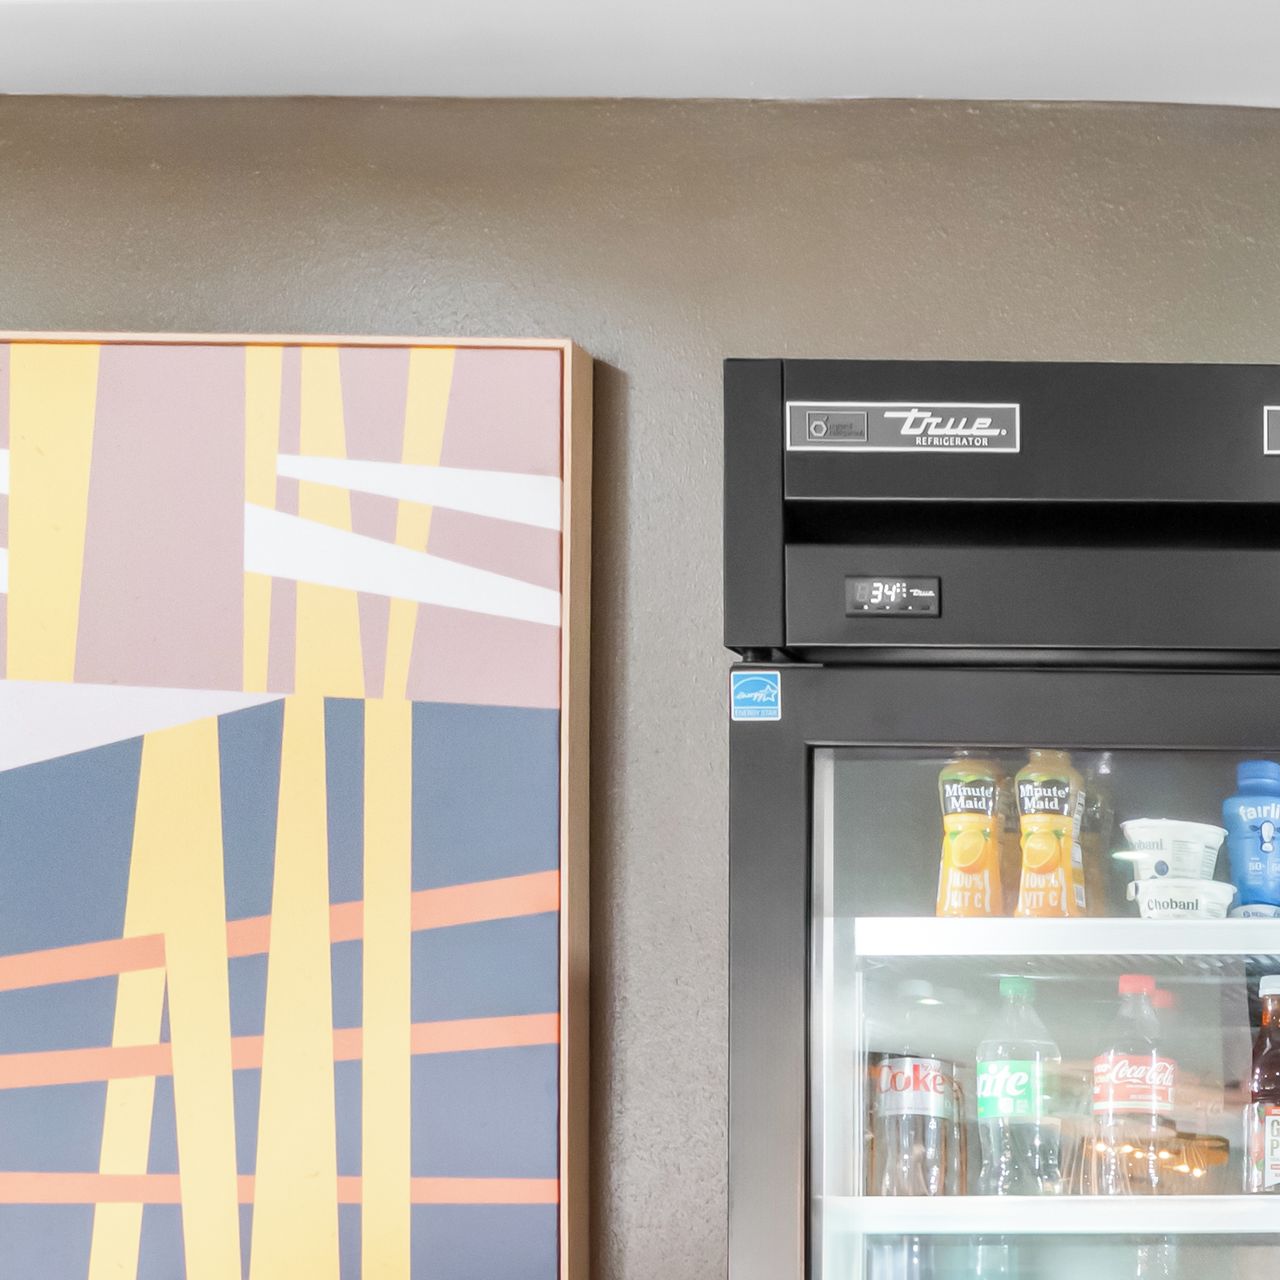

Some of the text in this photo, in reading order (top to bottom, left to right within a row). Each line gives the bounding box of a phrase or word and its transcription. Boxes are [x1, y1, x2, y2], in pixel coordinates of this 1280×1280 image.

[916, 437, 989, 446] REFRIGERATOR
[871, 582, 896, 603] 34
[945, 784, 993, 798] Minute
[1020, 784, 1066, 798] Minute
[951, 797, 986, 810] Maid
[1024, 797, 1059, 810] Maid
[1148, 898, 1199, 911] Chobani
